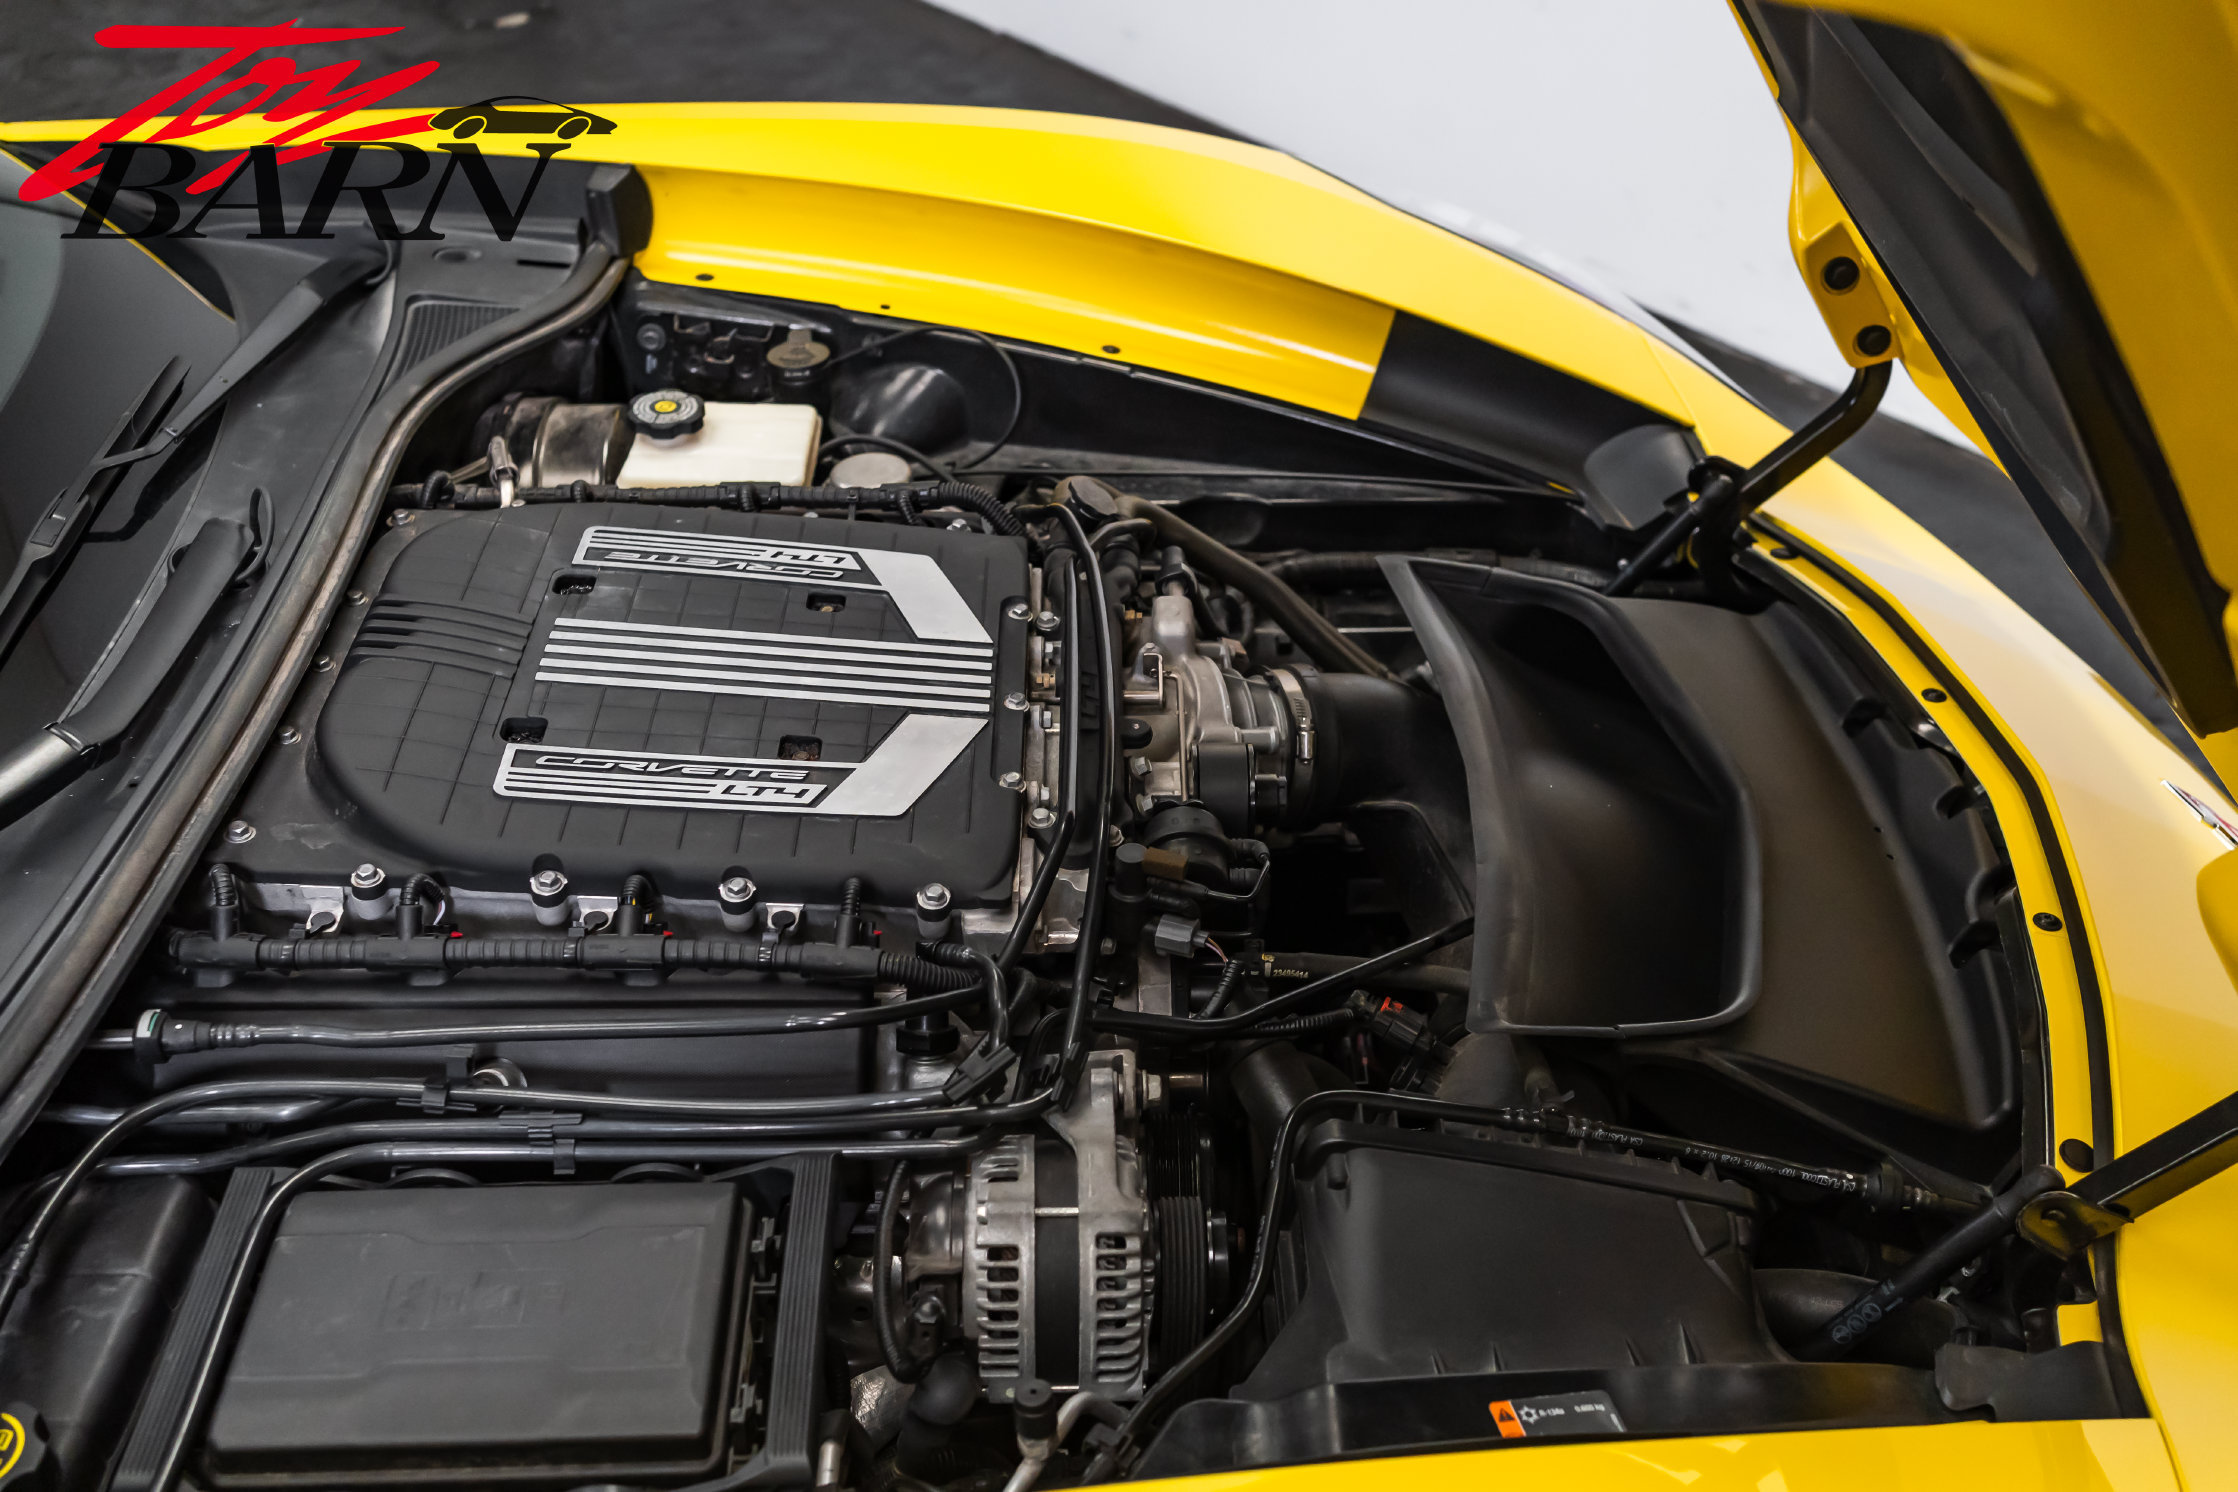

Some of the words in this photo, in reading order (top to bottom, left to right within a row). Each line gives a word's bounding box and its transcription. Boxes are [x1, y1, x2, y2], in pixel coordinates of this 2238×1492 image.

[603, 550, 844, 579] CORVETTE
[535, 754, 811, 781] CORVETTE
[721, 784, 810, 800] LT4
